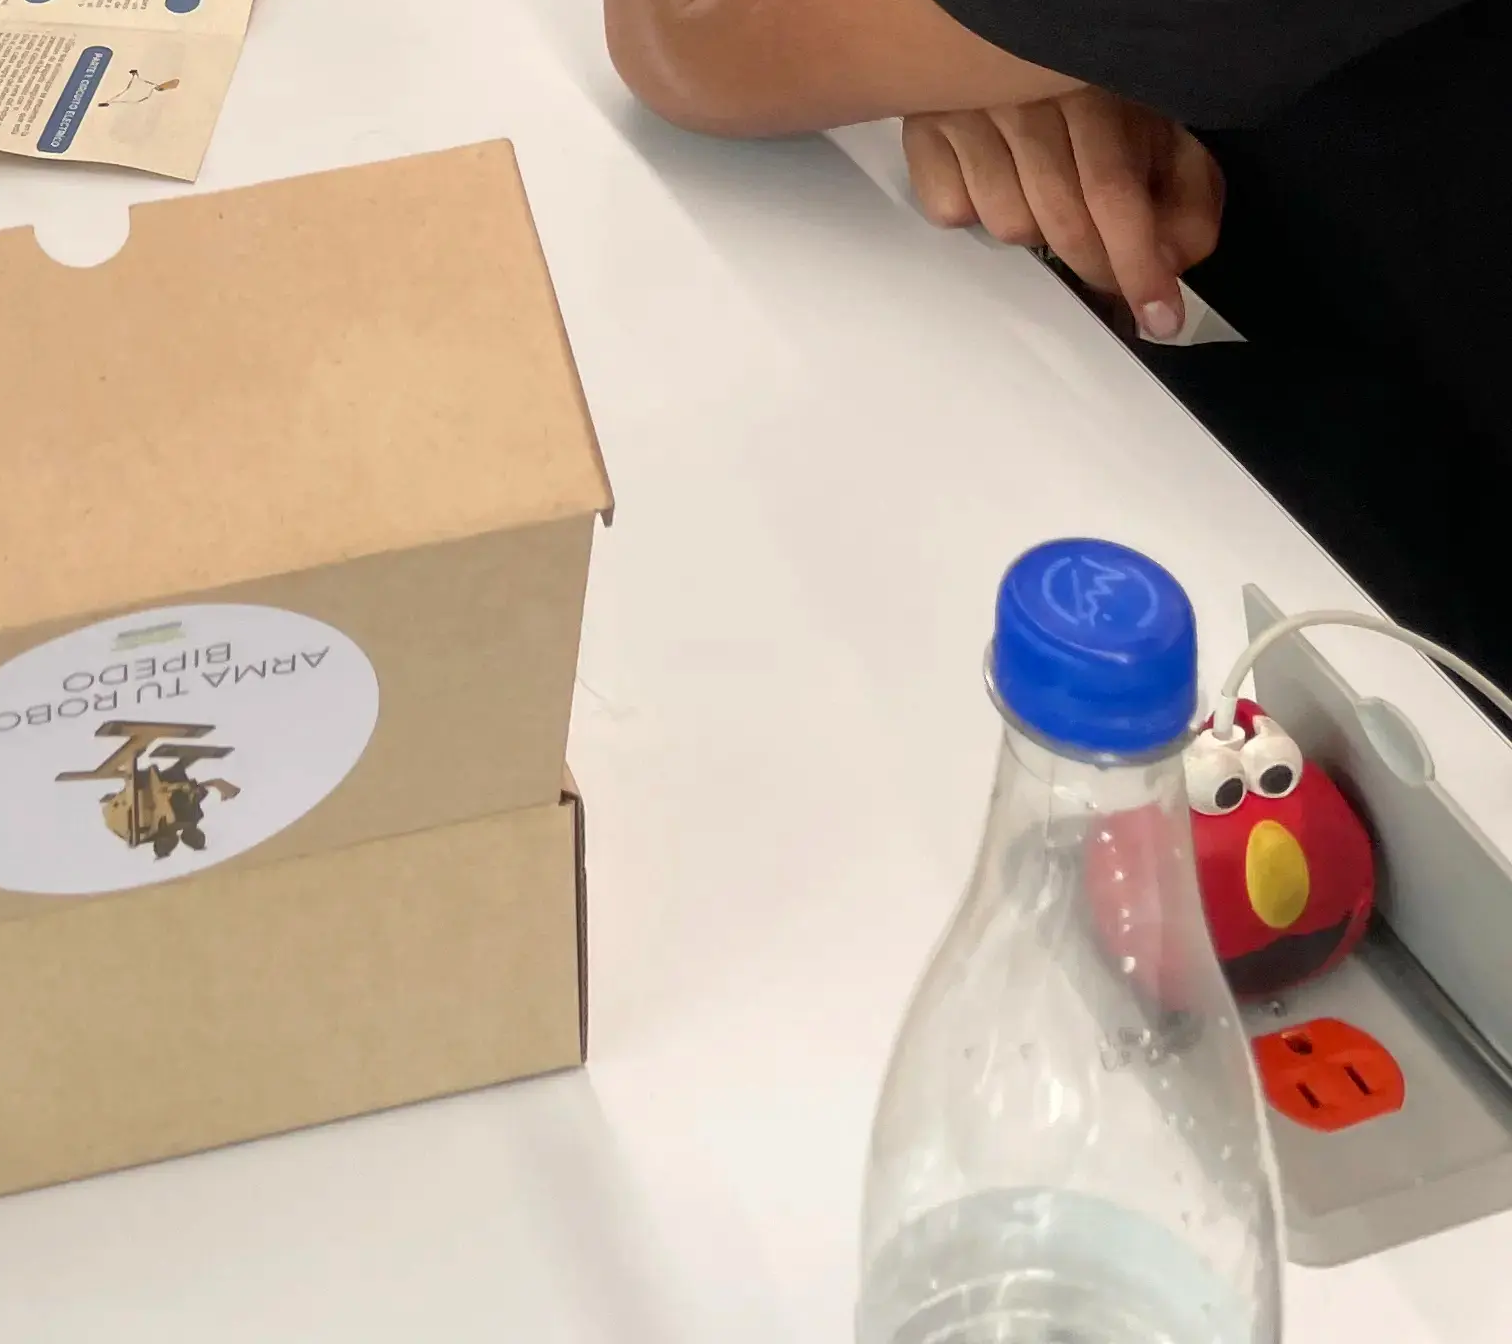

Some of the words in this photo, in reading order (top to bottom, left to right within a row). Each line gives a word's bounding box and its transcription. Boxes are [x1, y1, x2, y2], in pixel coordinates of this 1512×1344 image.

[62, 641, 232, 693] BIPEDO
[201, 645, 331, 688] ARMA
[136, 676, 190, 704] TU
